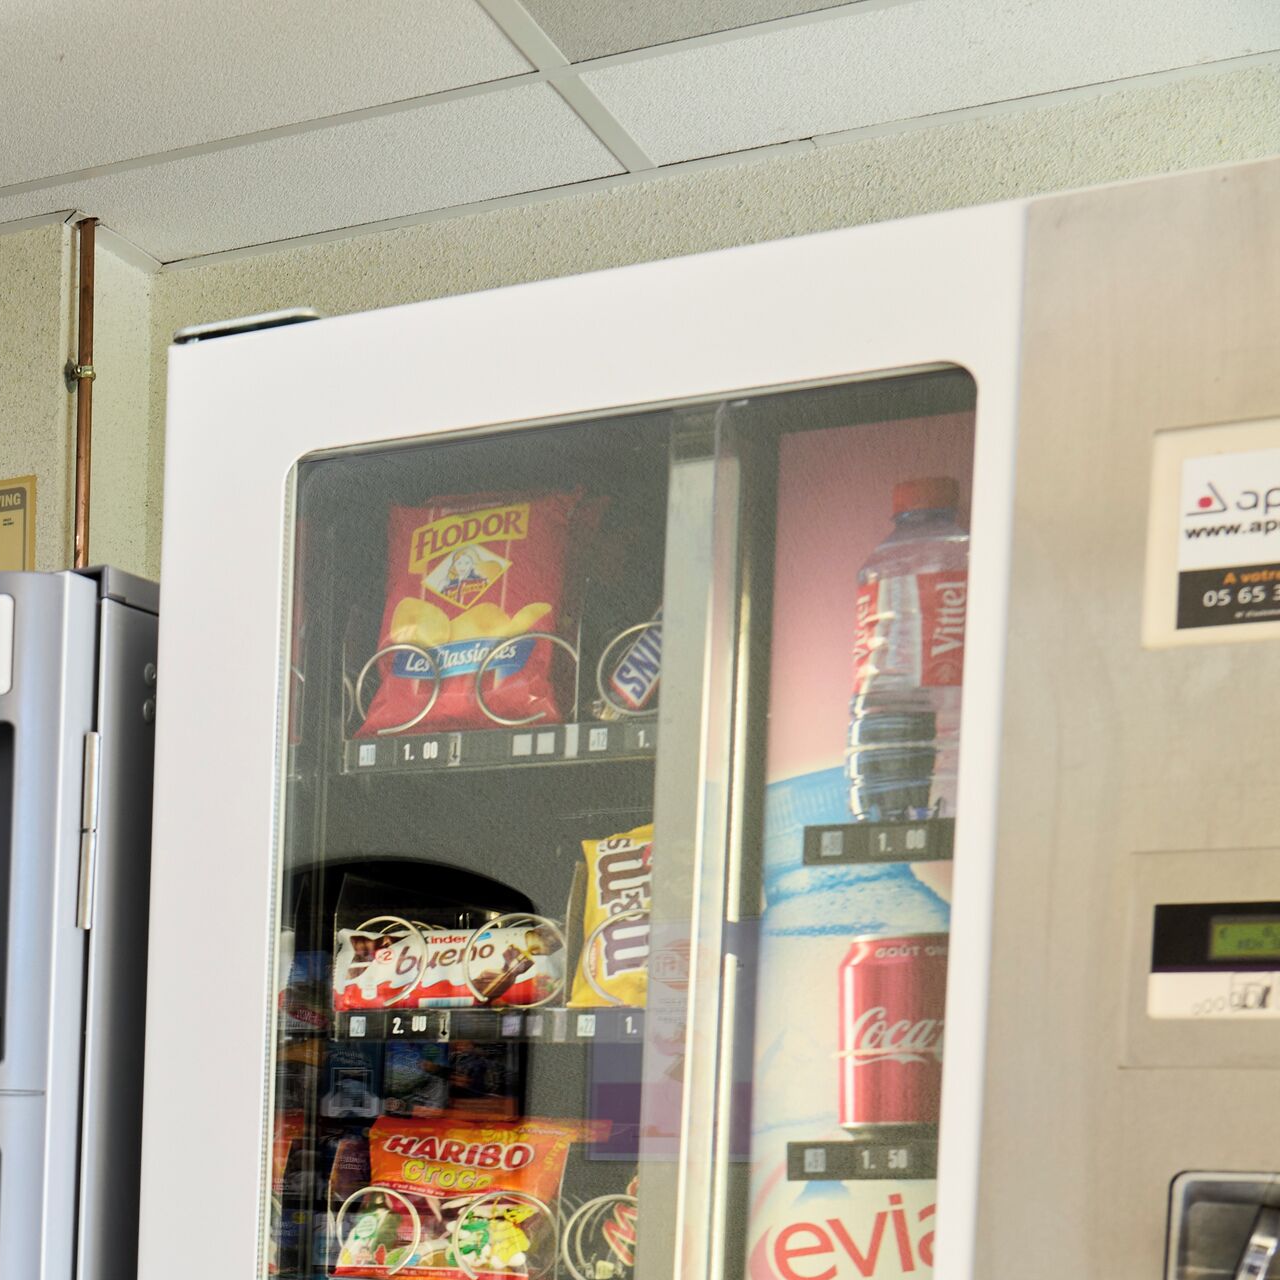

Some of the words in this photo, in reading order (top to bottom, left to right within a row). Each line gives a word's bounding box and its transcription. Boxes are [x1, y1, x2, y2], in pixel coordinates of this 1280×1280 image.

[415, 511, 524, 561] FLODOR
[1203, 589, 1230, 608] 05
[1238, 586, 1265, 603] 65
[931, 580, 966, 658] Vittel
[405, 653, 430, 672] Les
[395, 942, 495, 975] bueno
[384, 1134, 535, 1171] HARIBO
[402, 1160, 492, 1190] Croco
